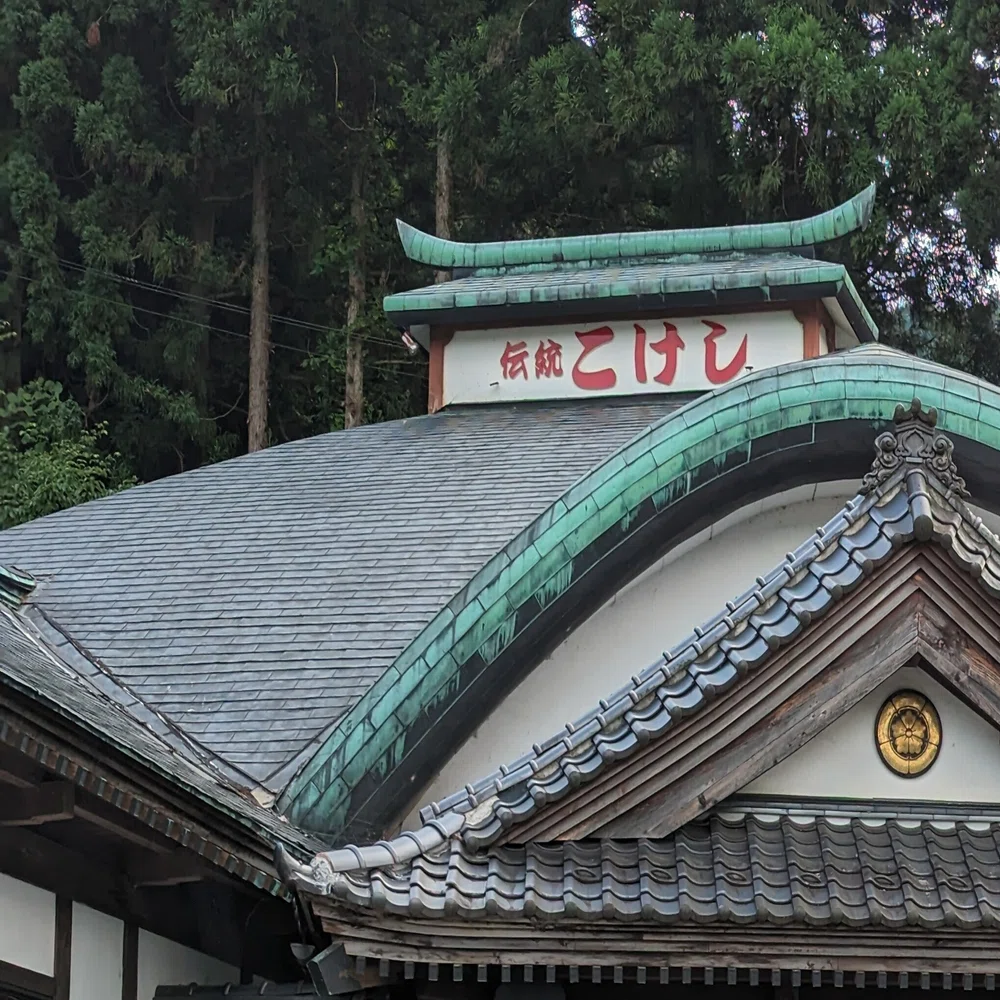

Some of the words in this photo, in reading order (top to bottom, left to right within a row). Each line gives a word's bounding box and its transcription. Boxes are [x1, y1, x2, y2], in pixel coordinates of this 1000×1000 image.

[500, 319, 748, 390] 伝統こけし
